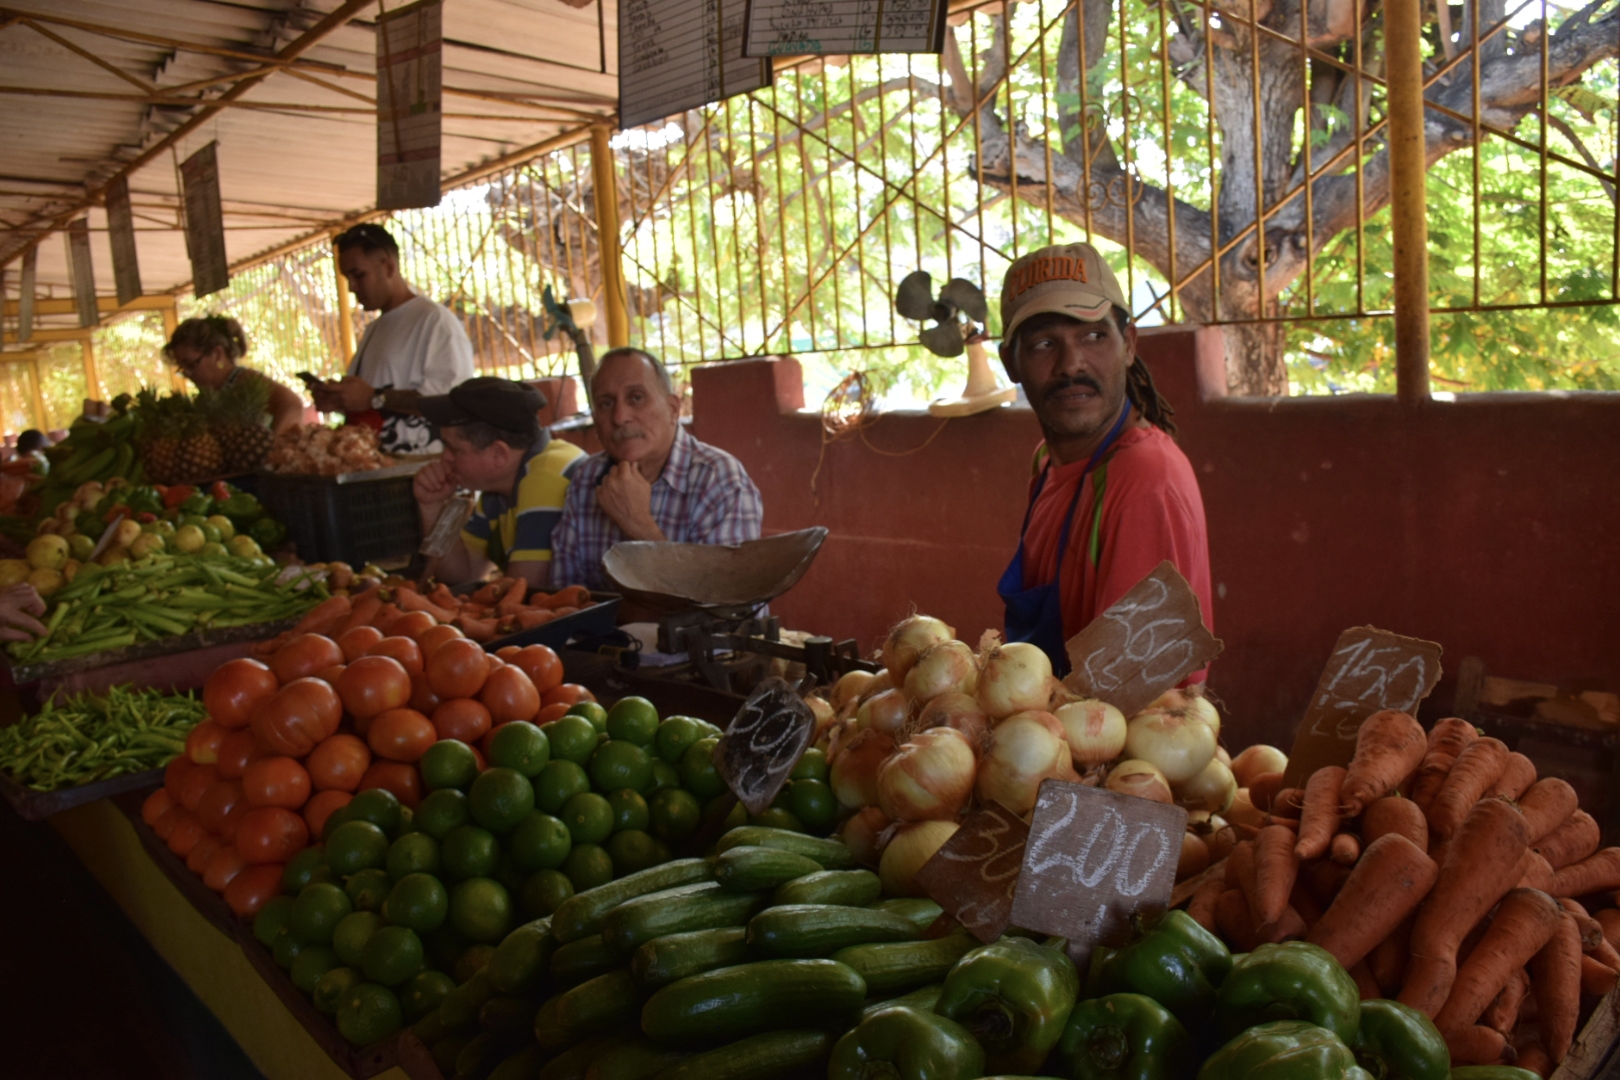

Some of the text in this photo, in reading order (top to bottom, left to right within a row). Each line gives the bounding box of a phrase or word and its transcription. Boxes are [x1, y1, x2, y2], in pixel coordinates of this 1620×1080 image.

[1008, 256, 1088, 301] FLORIDA
[1328, 638, 1424, 711] 150
[728, 689, 812, 774] 500
[939, 811, 1026, 900] 30
[1028, 792, 1169, 896] 200
